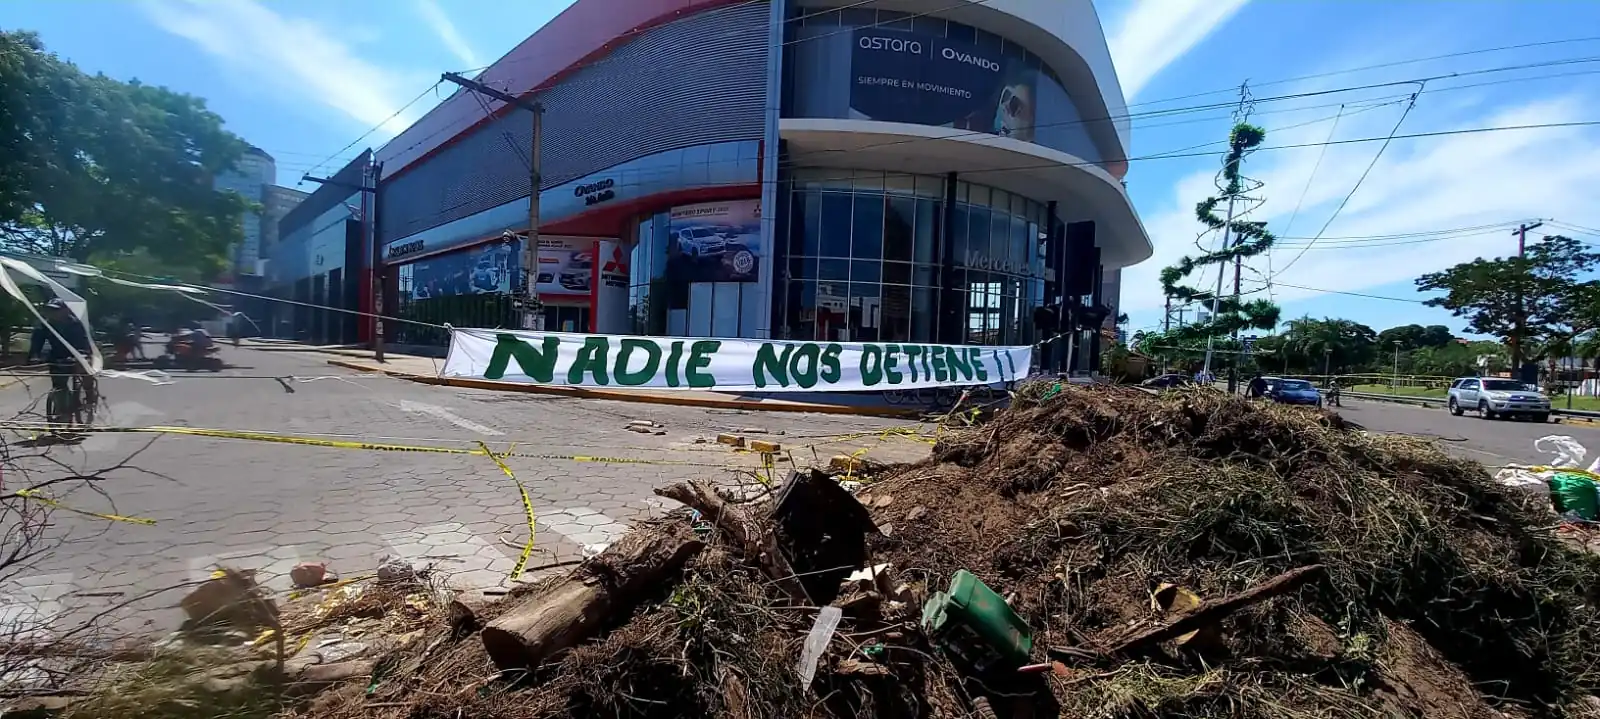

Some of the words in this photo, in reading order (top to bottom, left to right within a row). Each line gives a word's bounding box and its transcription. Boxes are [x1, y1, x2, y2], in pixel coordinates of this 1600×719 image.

[859, 36, 922, 54] astara
[941, 47, 1000, 72] OVANDO
[858, 76, 899, 88] SIEMPRE
[902, 79, 915, 89] EN
[916, 82, 972, 99] MOVIMIENTO
[483, 333, 722, 387] NADIE
[752, 342, 842, 388] NOS
[859, 343, 988, 386] DETIENE
